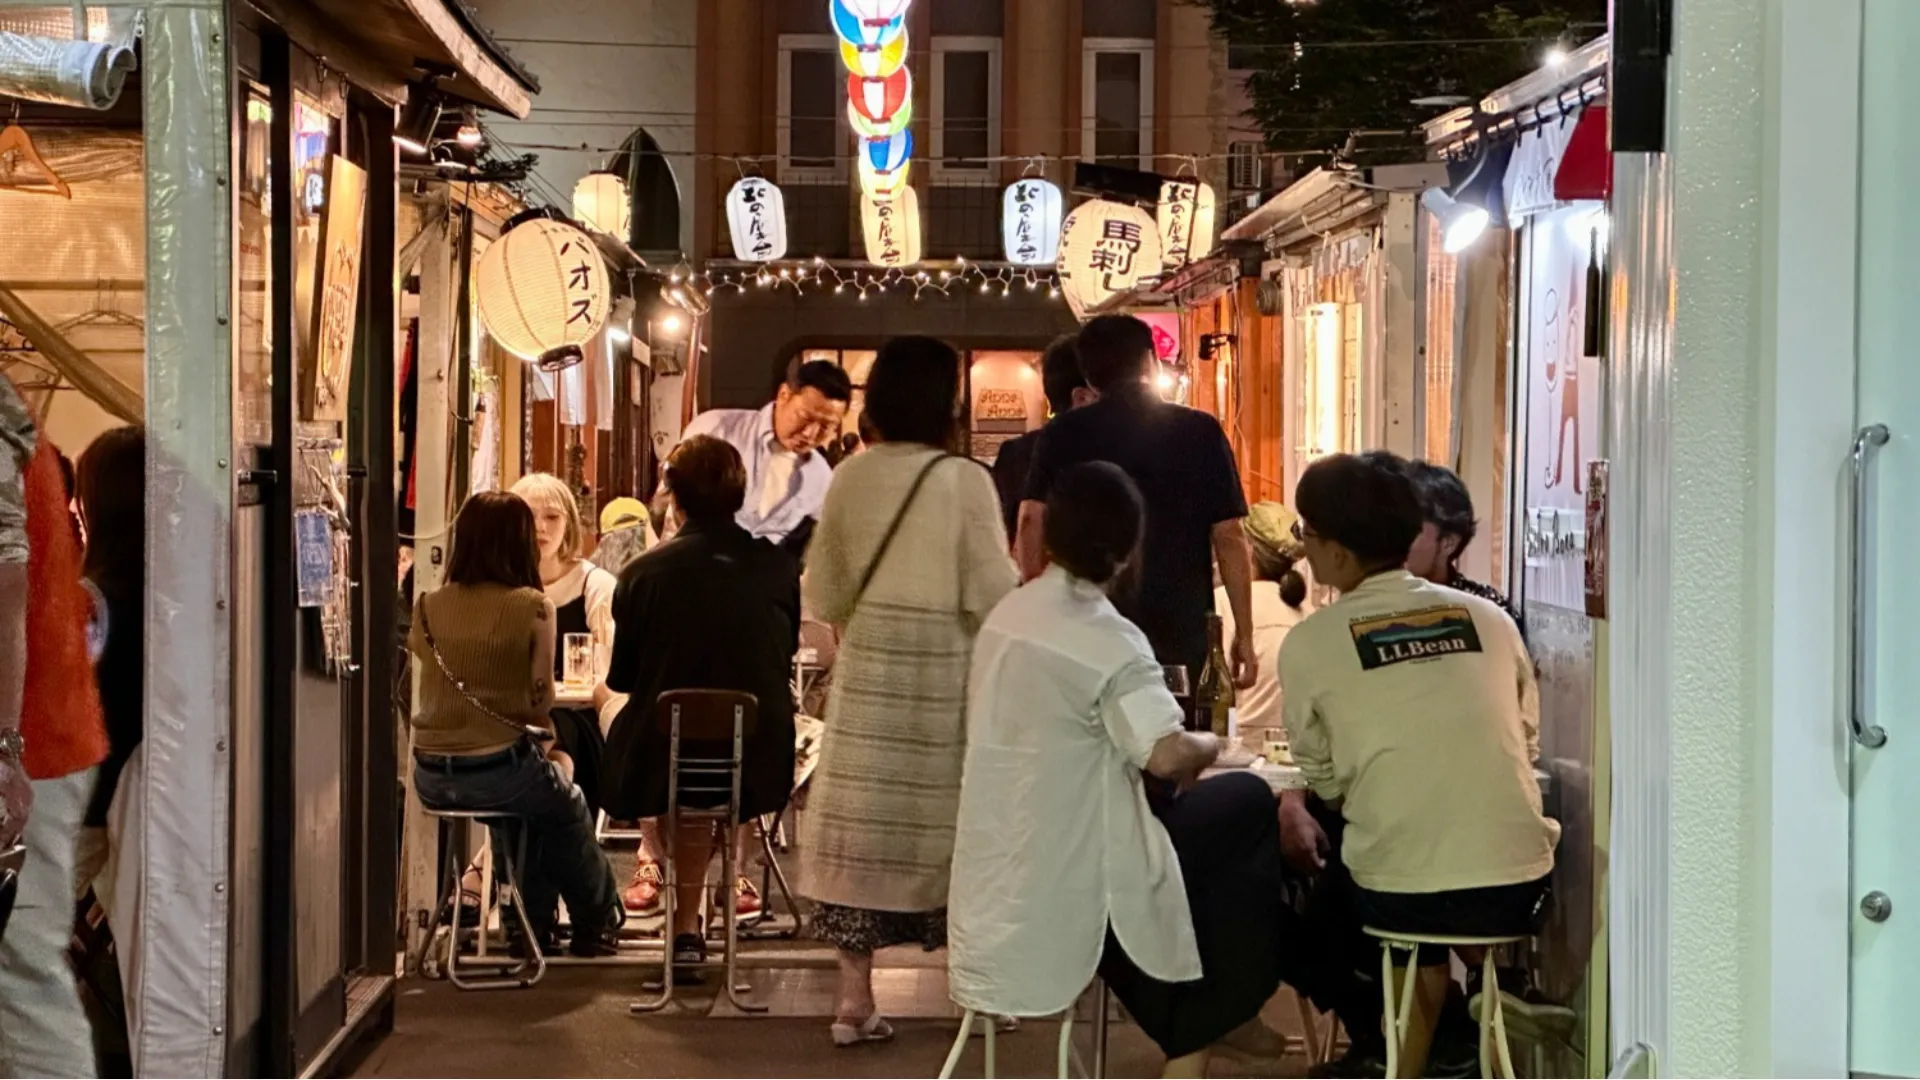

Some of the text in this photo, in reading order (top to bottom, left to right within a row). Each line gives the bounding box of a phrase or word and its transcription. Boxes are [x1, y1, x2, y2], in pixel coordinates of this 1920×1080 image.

[560, 236, 598, 325] パオズ
[1088, 219, 1142, 293] 馬刺し
